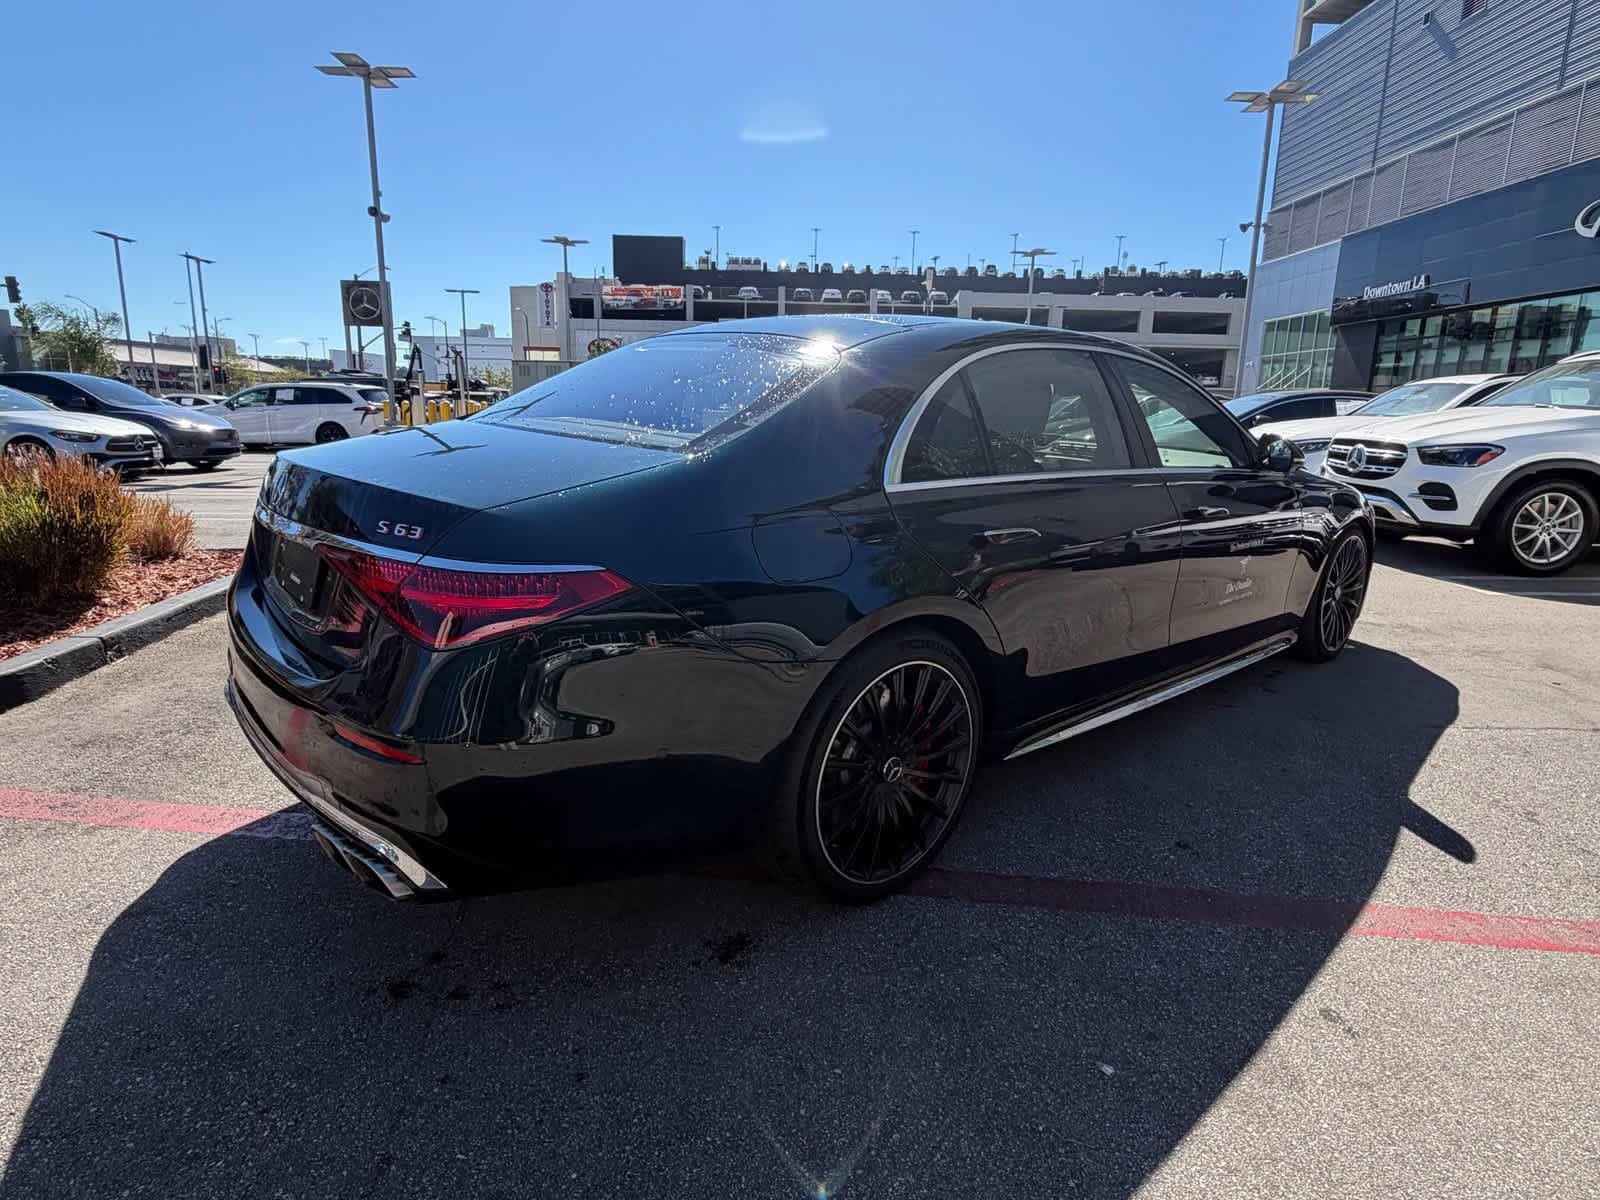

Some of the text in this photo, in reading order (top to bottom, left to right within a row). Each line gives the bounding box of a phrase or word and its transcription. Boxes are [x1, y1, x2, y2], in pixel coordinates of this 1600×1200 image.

[1363, 274, 1425, 300] Downtown LA
[376, 520, 423, 540] S 63
